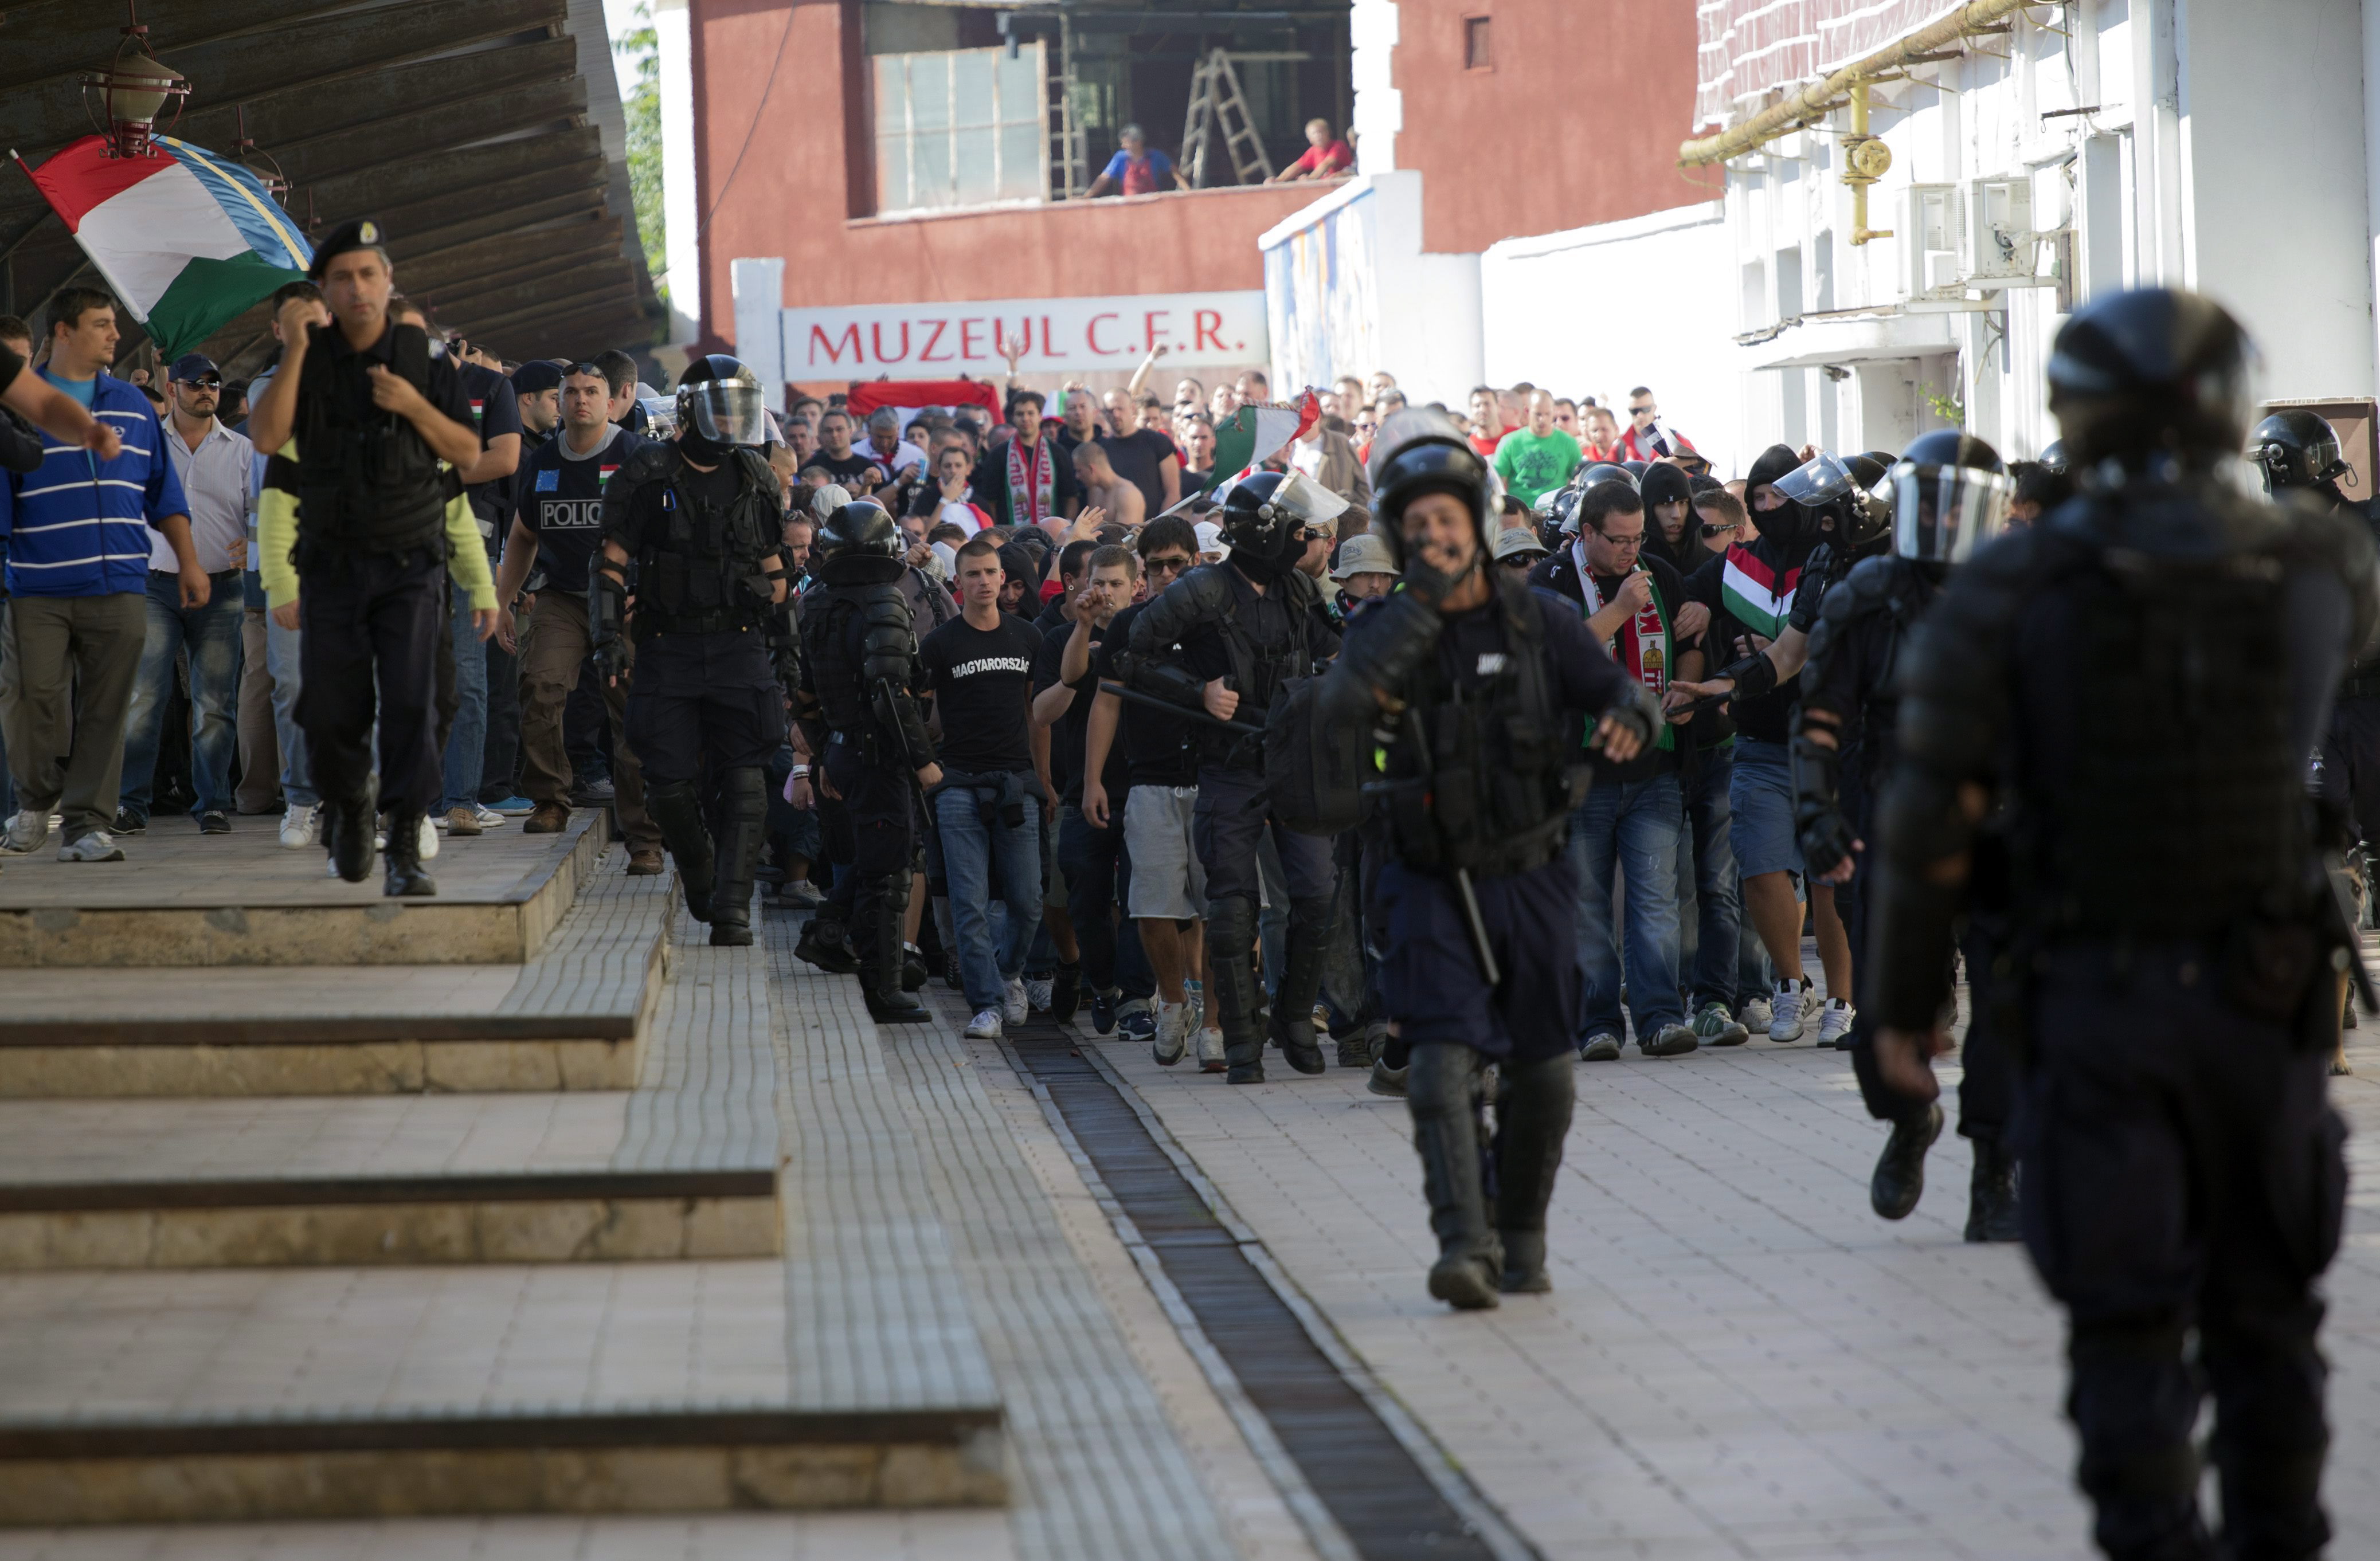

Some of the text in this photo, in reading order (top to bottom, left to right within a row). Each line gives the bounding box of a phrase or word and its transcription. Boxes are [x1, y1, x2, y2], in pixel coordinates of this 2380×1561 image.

[808, 316, 1067, 366] MUZEUL
[544, 502, 601, 526] POLIC
[952, 656, 1029, 678] MAGYARORSZÁG
